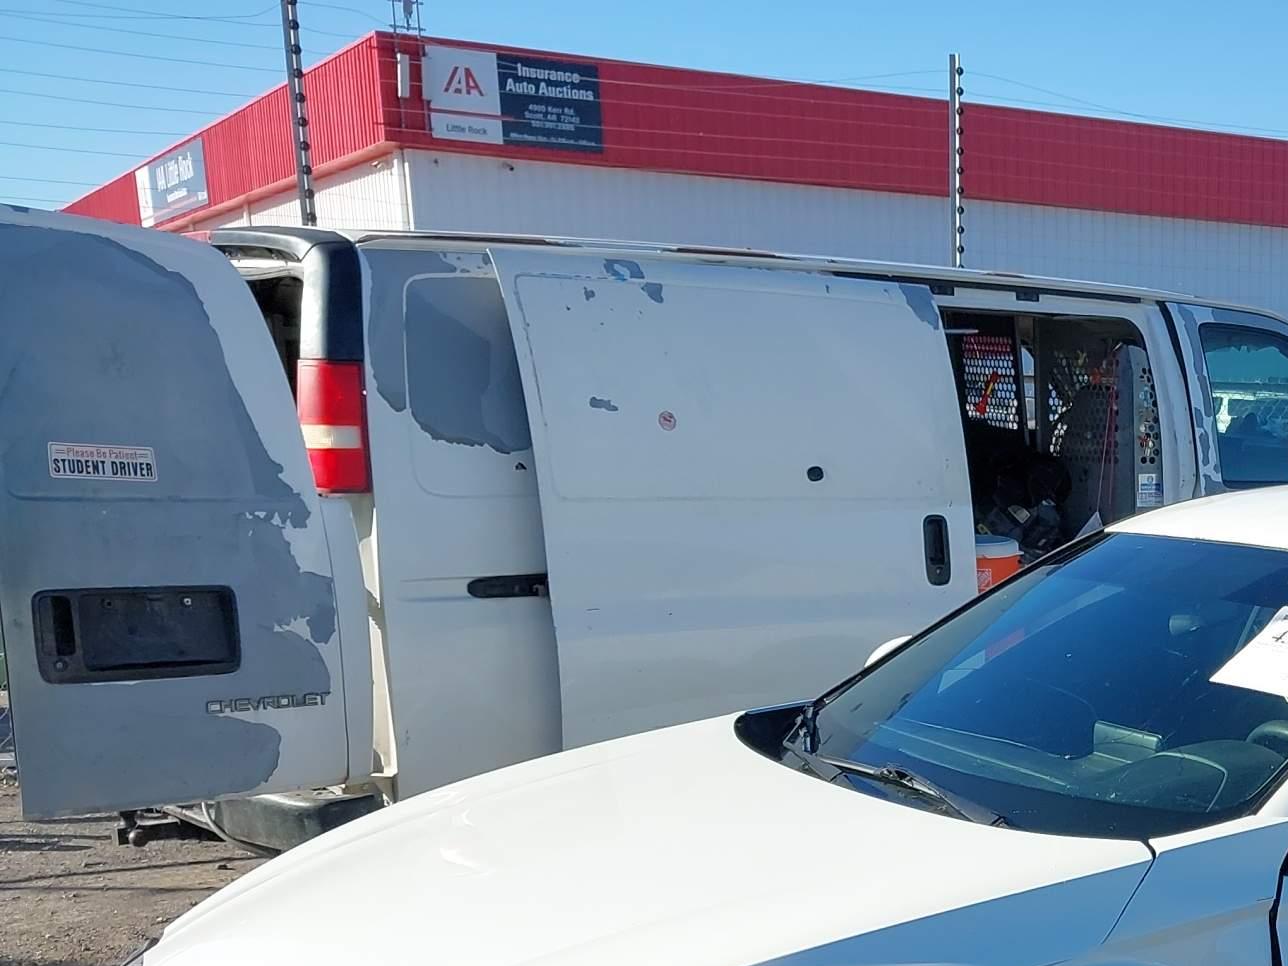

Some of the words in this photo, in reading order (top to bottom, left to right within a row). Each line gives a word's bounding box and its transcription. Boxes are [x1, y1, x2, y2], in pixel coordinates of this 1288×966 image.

[517, 63, 581, 83] Insurance
[505, 78, 535, 95] Auto
[539, 82, 594, 101] Auctions
[447, 123, 466, 133] Little
[468, 125, 487, 135] Rock
[66, 447, 95, 458] Please
[96, 449, 108, 459] Be
[109, 450, 138, 461] Patient
[53, 458, 106, 476] STUDENT
[110, 461, 154, 477] DRIVER
[206, 691, 332, 714] CHEVROLET
